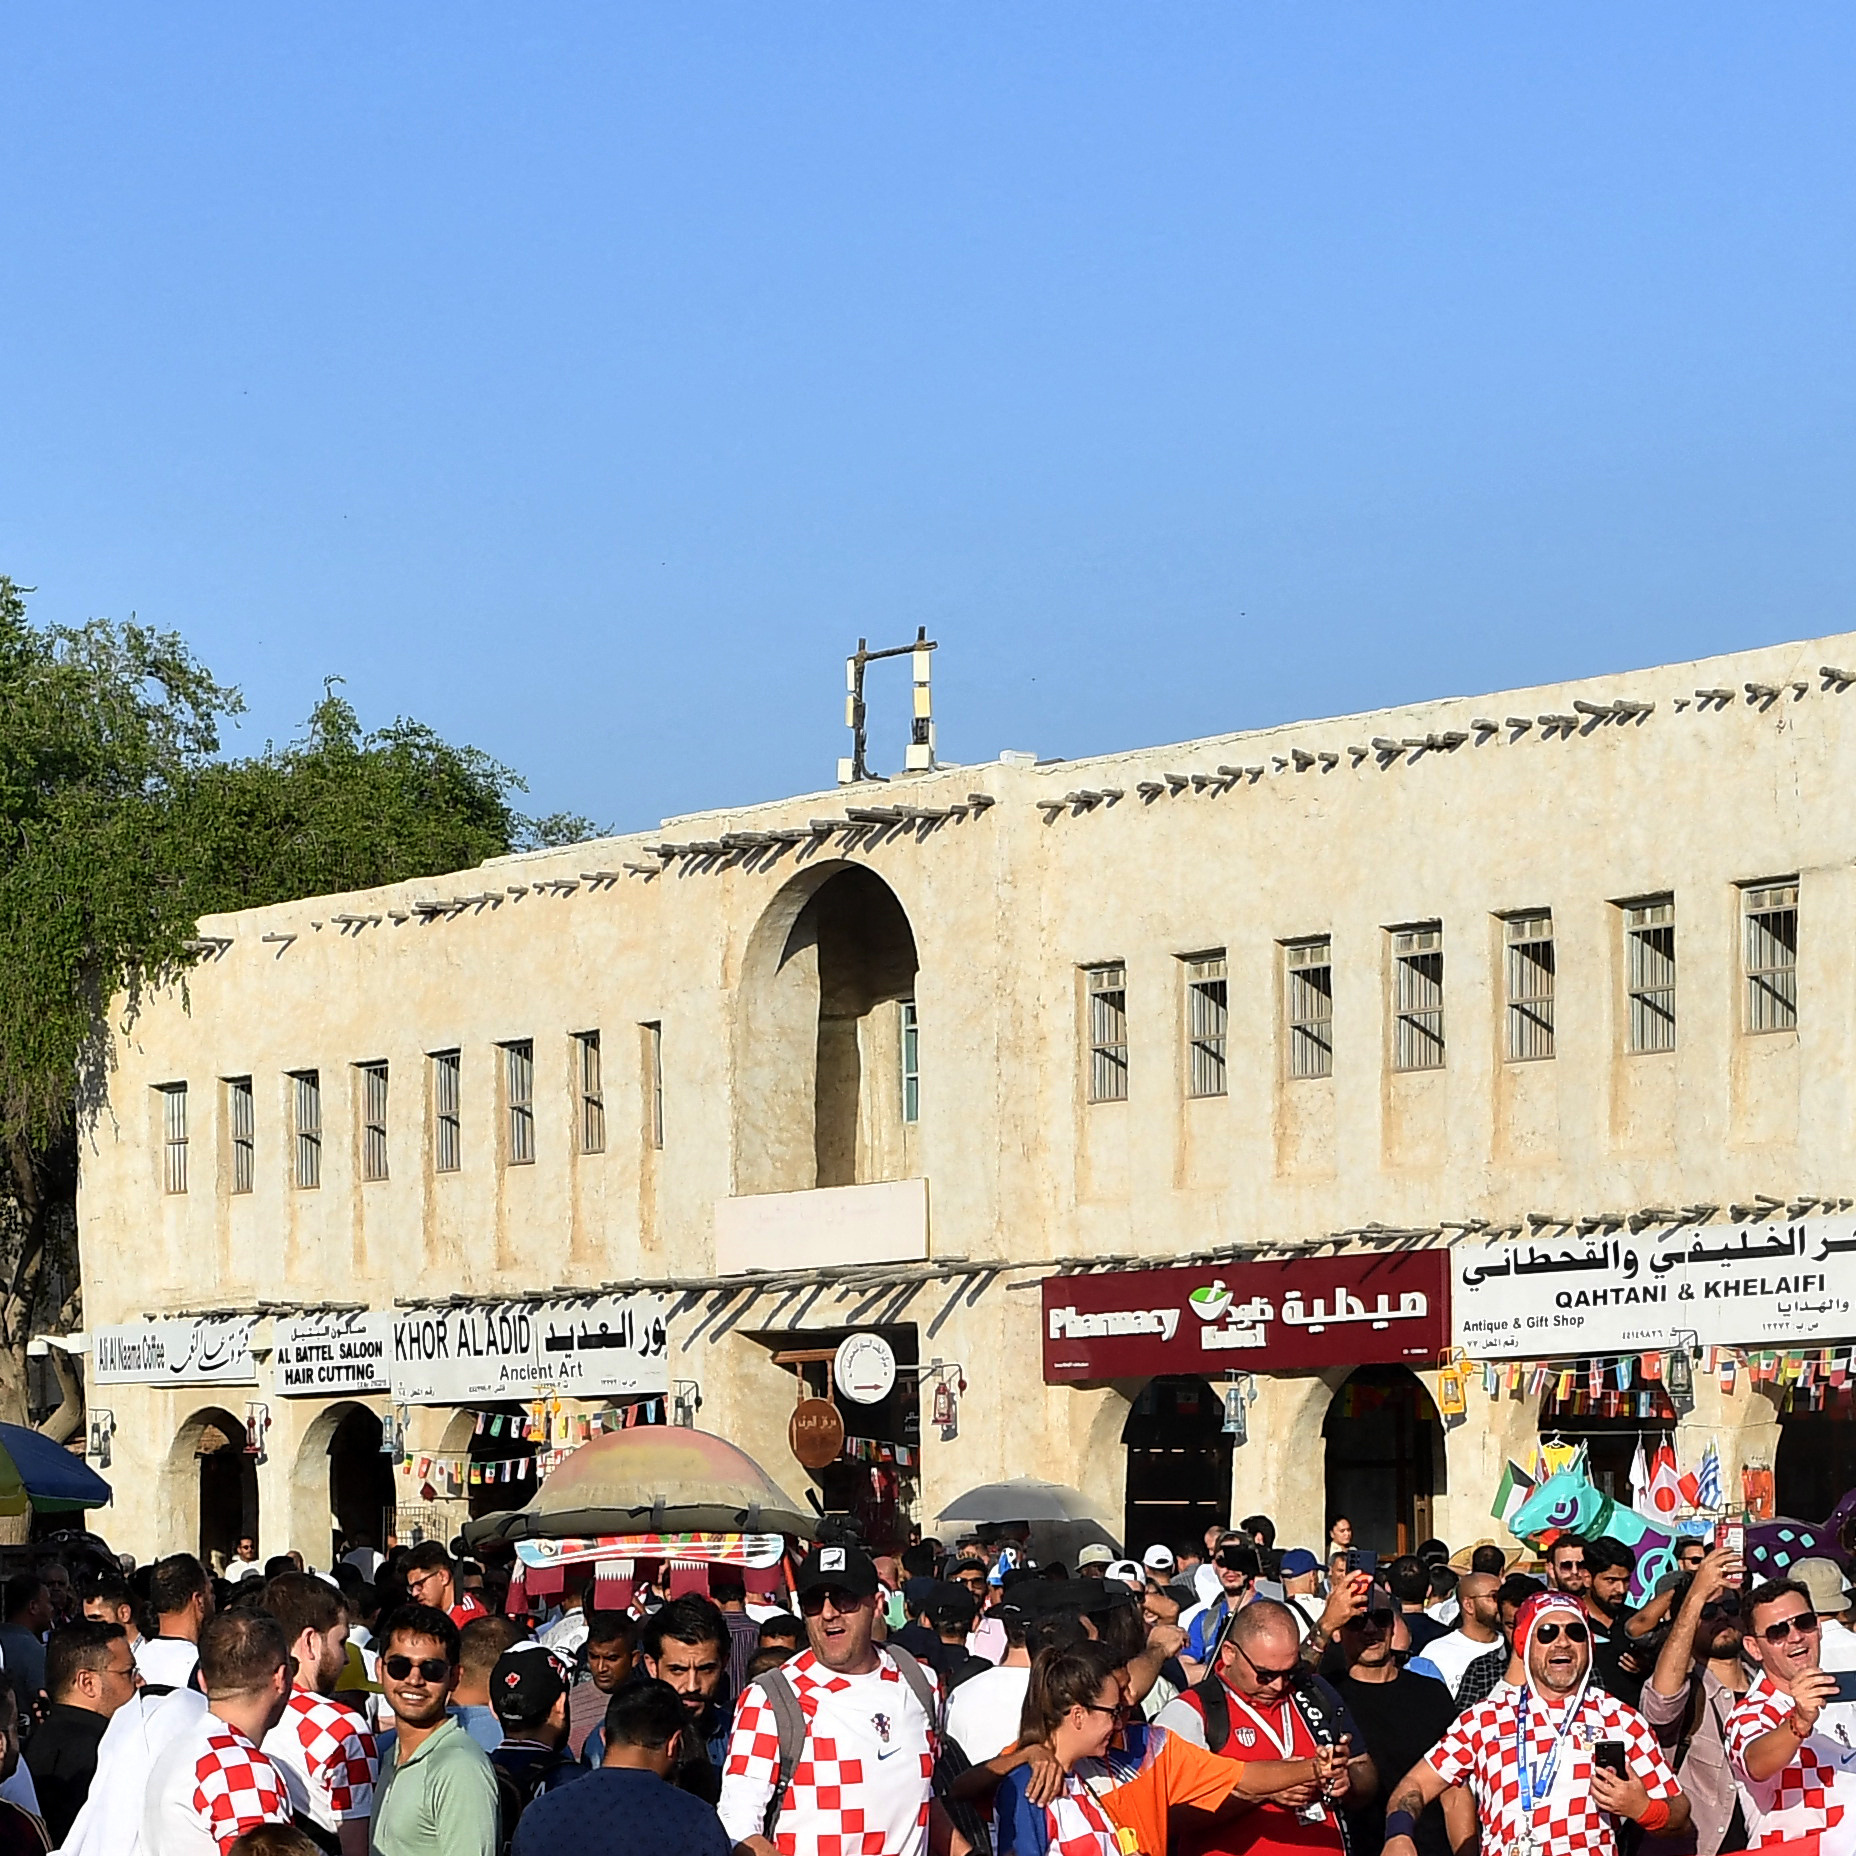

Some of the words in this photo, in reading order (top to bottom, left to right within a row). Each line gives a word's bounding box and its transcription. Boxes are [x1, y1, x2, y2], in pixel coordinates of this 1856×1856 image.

[1462, 1238, 1639, 1292] والقحطاني
[1649, 1224, 1807, 1280] الخليفي
[1555, 1285, 1667, 1309] QAHTANI
[1677, 1283, 1695, 1301] &
[1704, 1274, 1825, 1299] KHELAIFI
[1776, 1297, 1850, 1317] والهدايا
[1049, 1306, 1180, 1342] Pharmacy
[1281, 1287, 1427, 1333] صيدلية
[1463, 1318, 1508, 1334] Antique
[1512, 1318, 1522, 1329] &
[1527, 1315, 1549, 1329] Gift
[1553, 1315, 1585, 1329] Shop
[394, 1320, 449, 1361] KHOR
[457, 1314, 531, 1358] ALADID
[545, 1308, 634, 1360] العديد
[1504, 1335, 1519, 1348] رقم
[278, 1348, 291, 1364] AL
[295, 1344, 334, 1363] BATTEL
[339, 1341, 383, 1359] SALOON
[285, 1368, 314, 1385] HAIR
[317, 1363, 375, 1383] CUTTING
[500, 1363, 553, 1381] Ancient
[559, 1361, 583, 1378] Art
